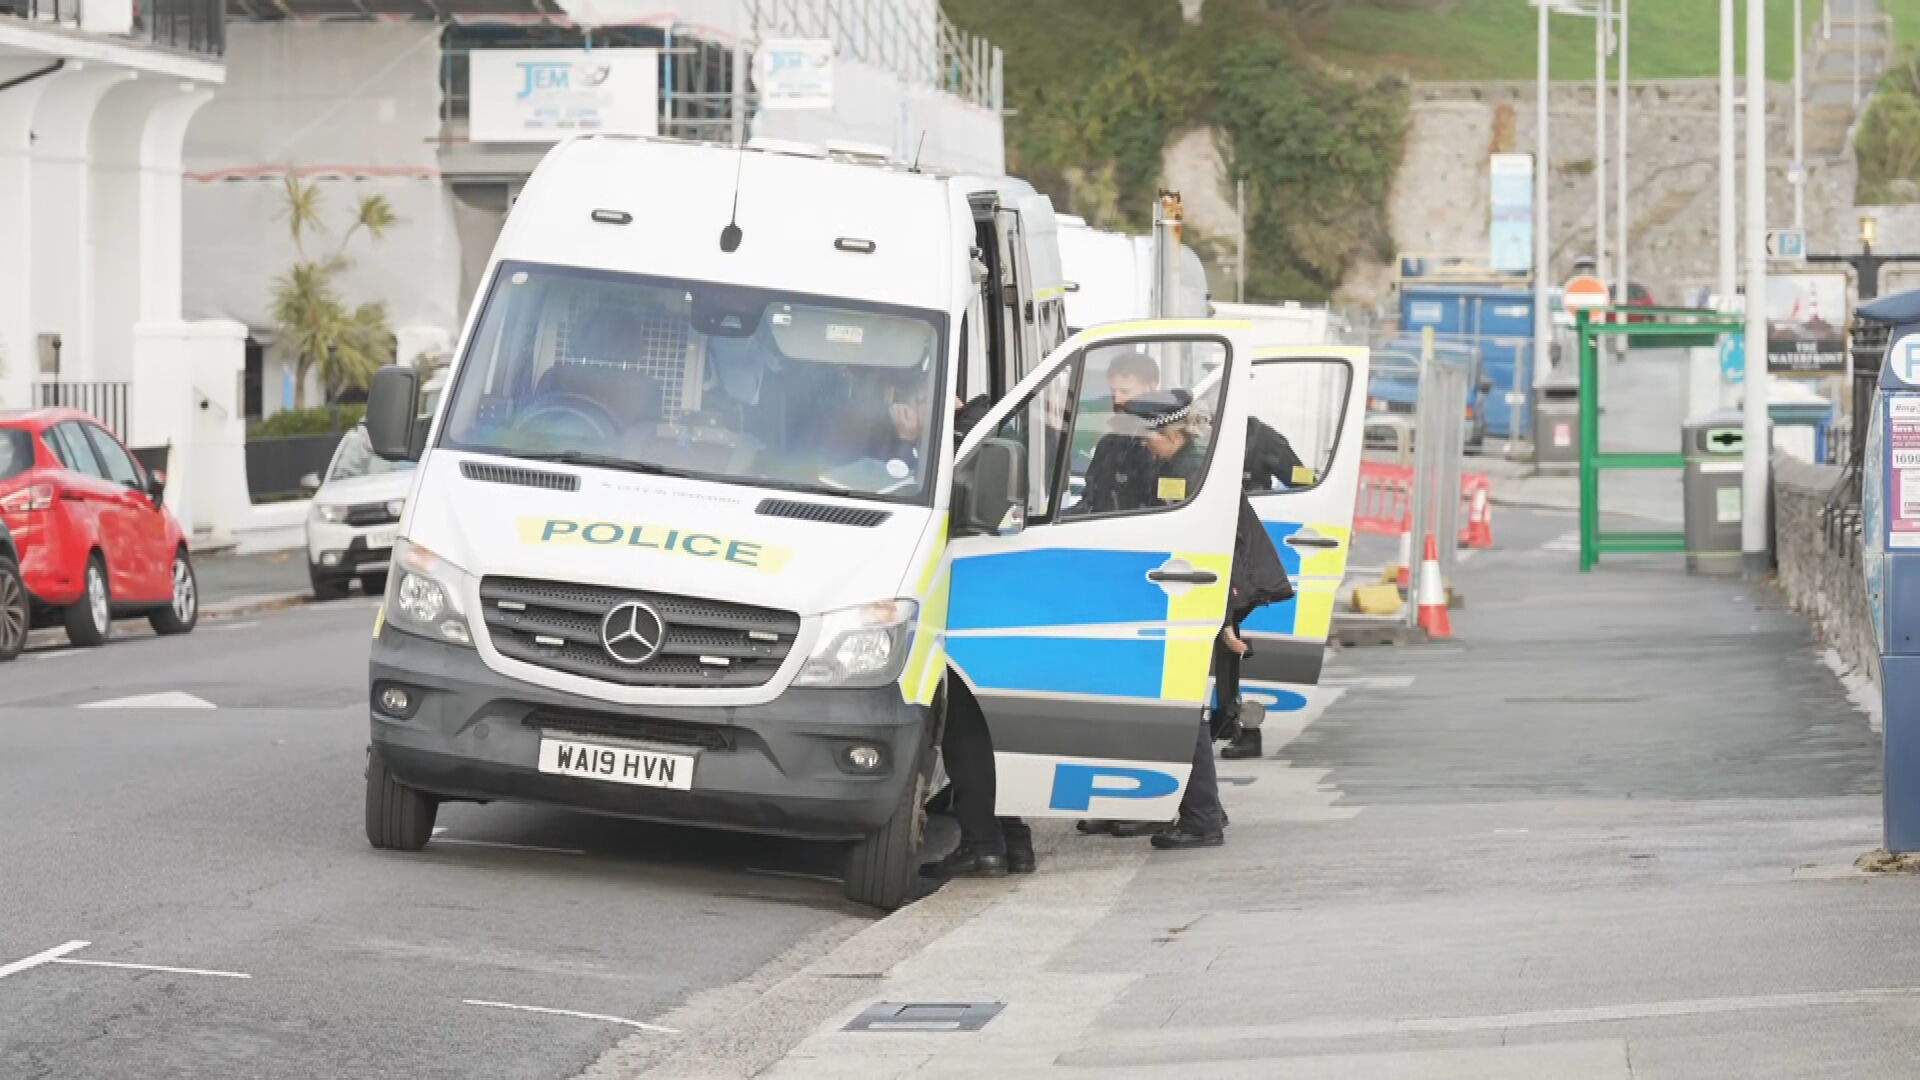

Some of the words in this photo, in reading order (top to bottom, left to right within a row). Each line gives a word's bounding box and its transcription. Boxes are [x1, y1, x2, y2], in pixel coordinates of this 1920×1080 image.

[516, 61, 573, 99] JEM
[1767, 351, 1843, 364] WATERFRONT
[1795, 341, 1817, 352] THE
[1895, 403, 1920, 414] Ring
[541, 519, 762, 567] POLICE
[557, 745, 616, 775] WA19
[623, 753, 676, 783] HVN
[1049, 763, 1180, 811] P
